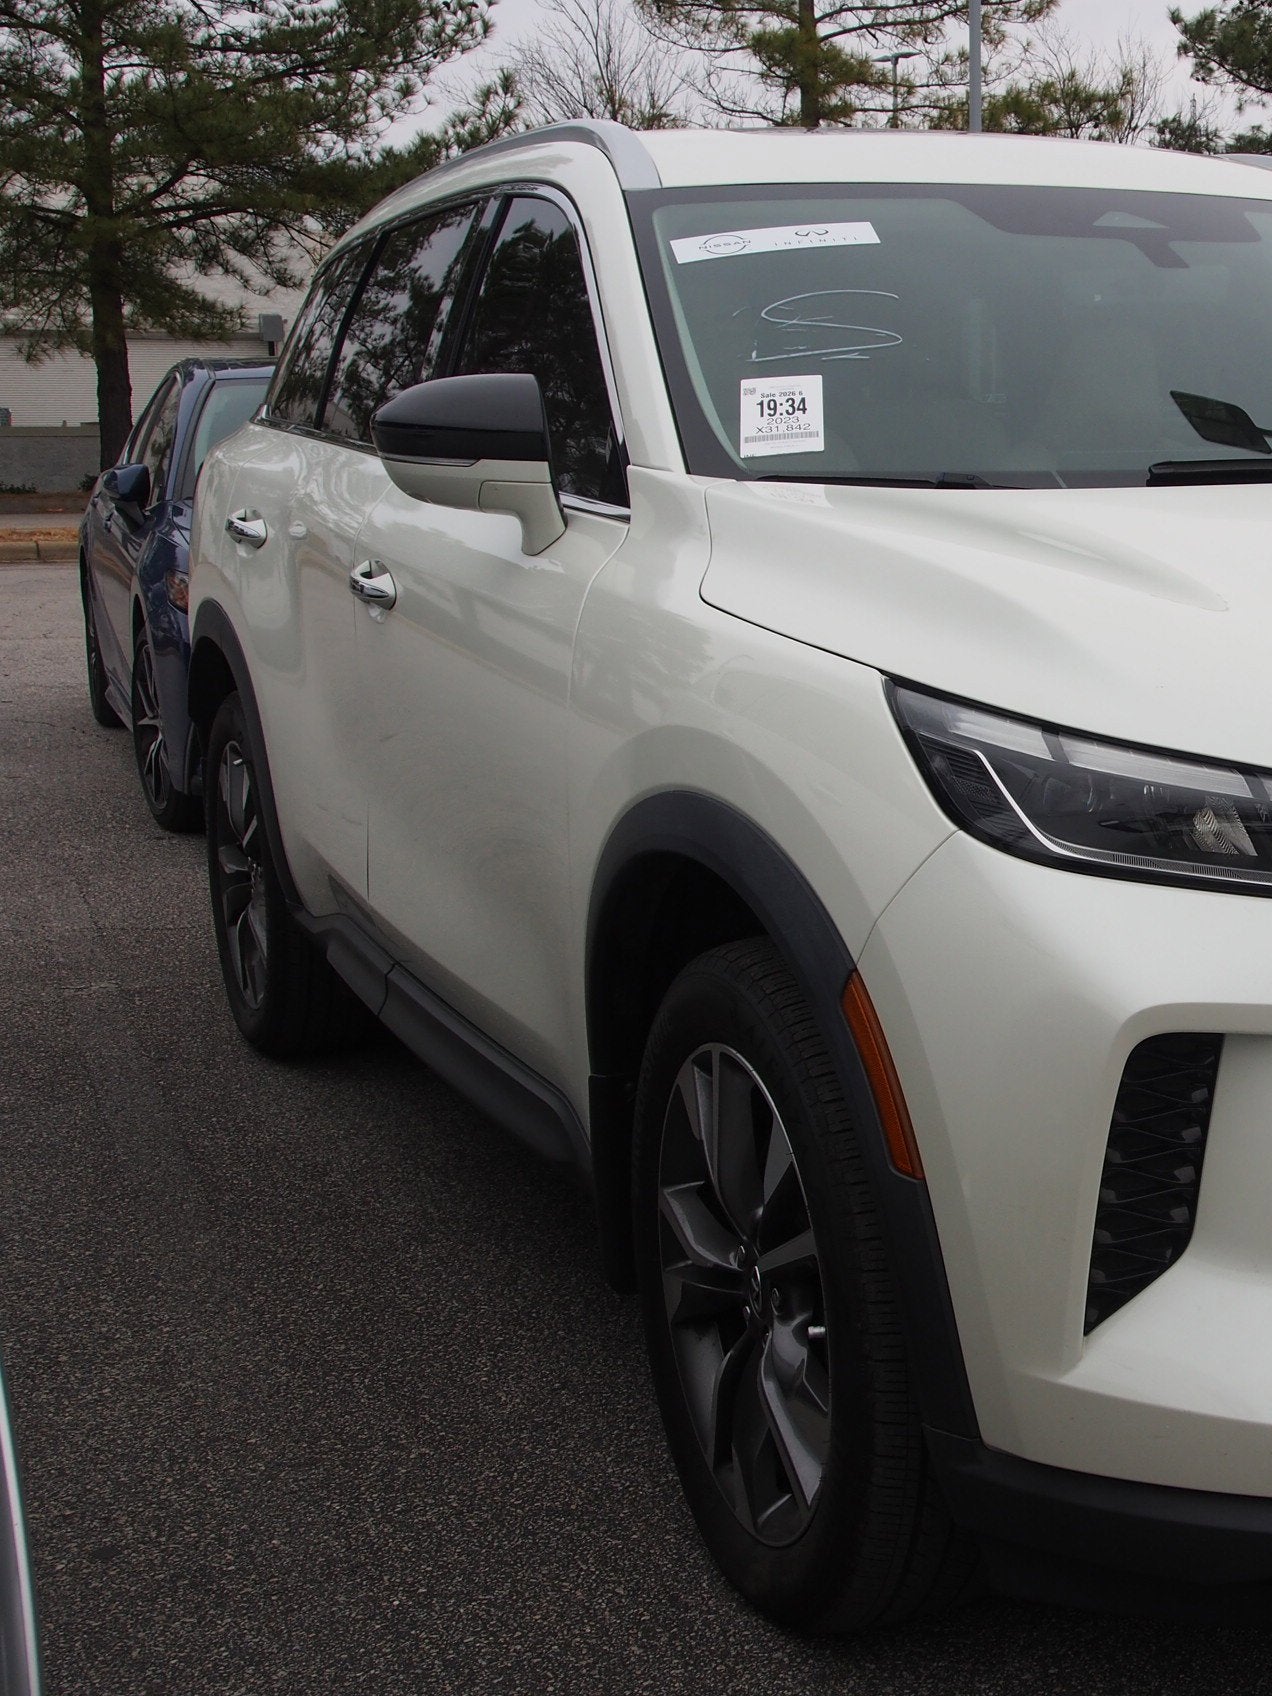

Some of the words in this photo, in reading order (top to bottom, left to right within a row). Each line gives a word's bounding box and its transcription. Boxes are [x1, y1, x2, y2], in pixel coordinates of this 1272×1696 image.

[699, 239, 751, 250] NISSAN
[775, 236, 858, 247] INFINITI
[756, 397, 808, 418] 19:34
[767, 416, 800, 426] 2023
